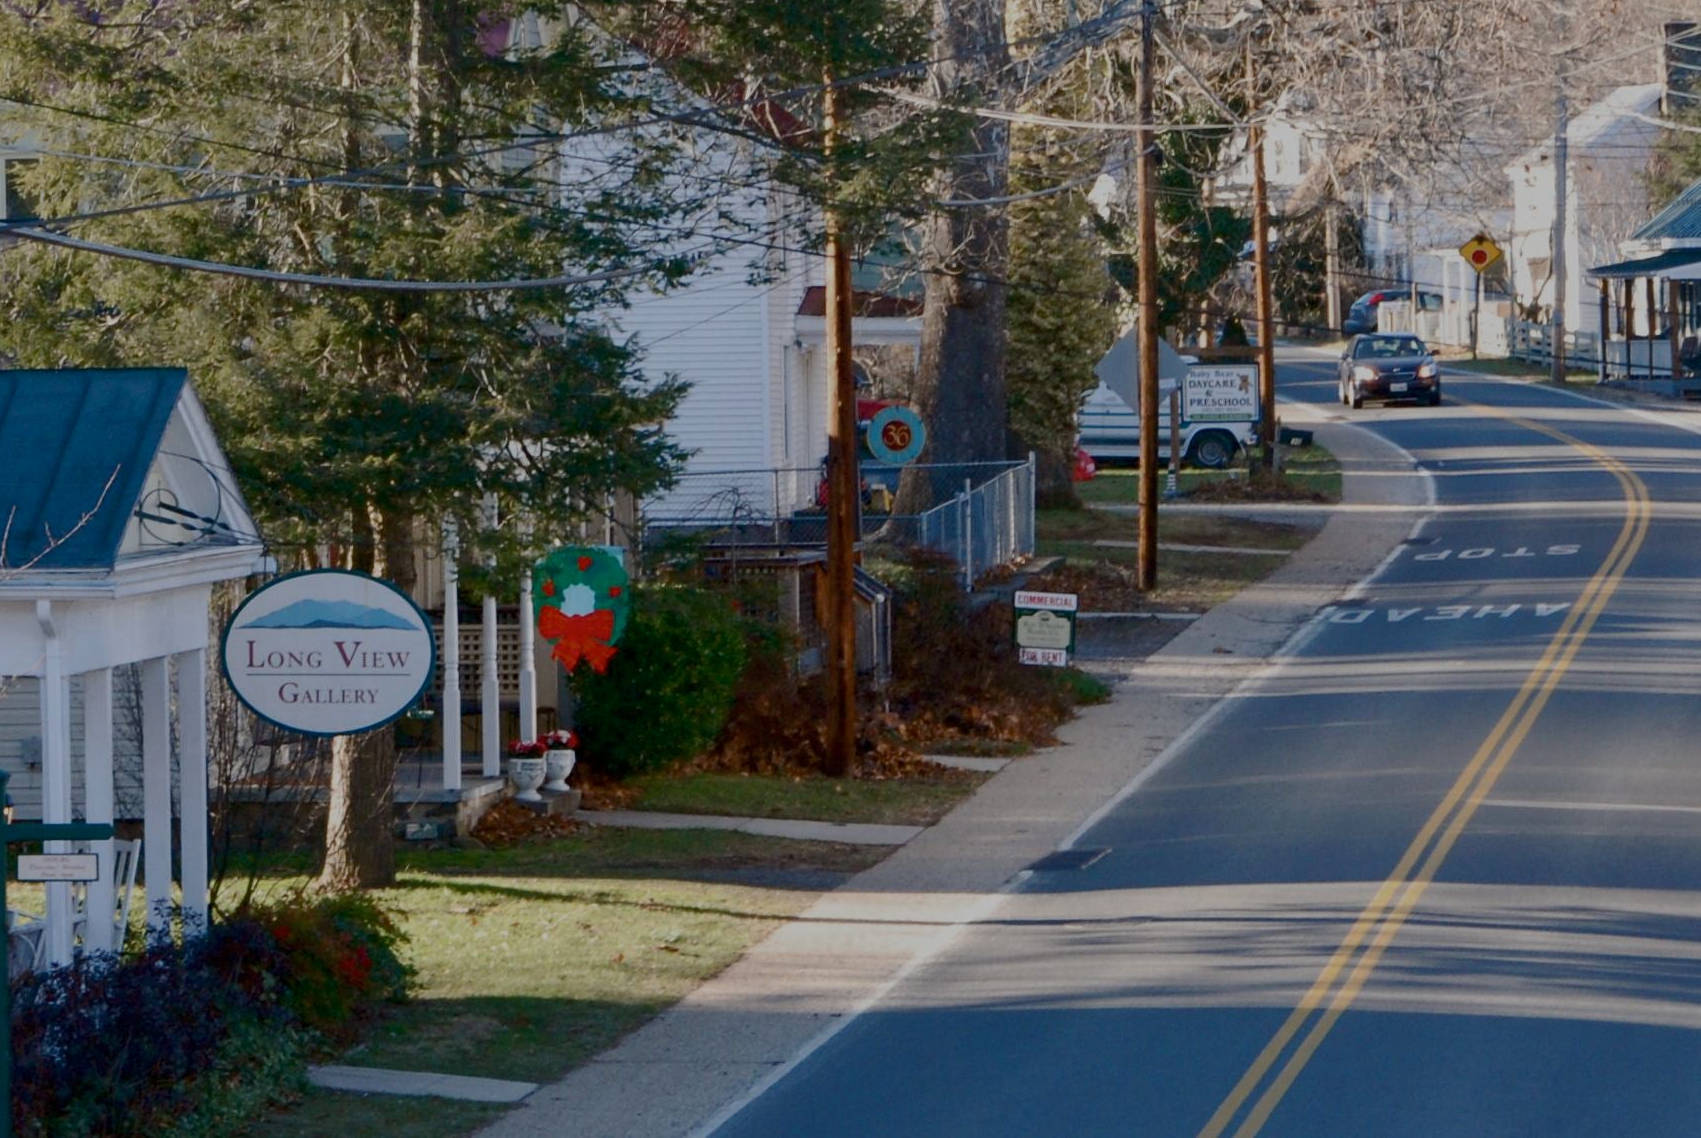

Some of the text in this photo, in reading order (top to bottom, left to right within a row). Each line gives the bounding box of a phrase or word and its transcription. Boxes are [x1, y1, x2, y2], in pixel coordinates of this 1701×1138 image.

[1189, 380, 1236, 388] DAYCARE
[1189, 398, 1252, 407] PRESCHOOL
[1414, 544, 1581, 561] STOP
[1018, 595, 1073, 608] COMMERCIAL
[1330, 603, 1571, 623] AHEAD
[247, 640, 411, 668] LONG VIEW
[1021, 649, 1063, 662] FOR RENT
[278, 682, 379, 704] GALLERY
